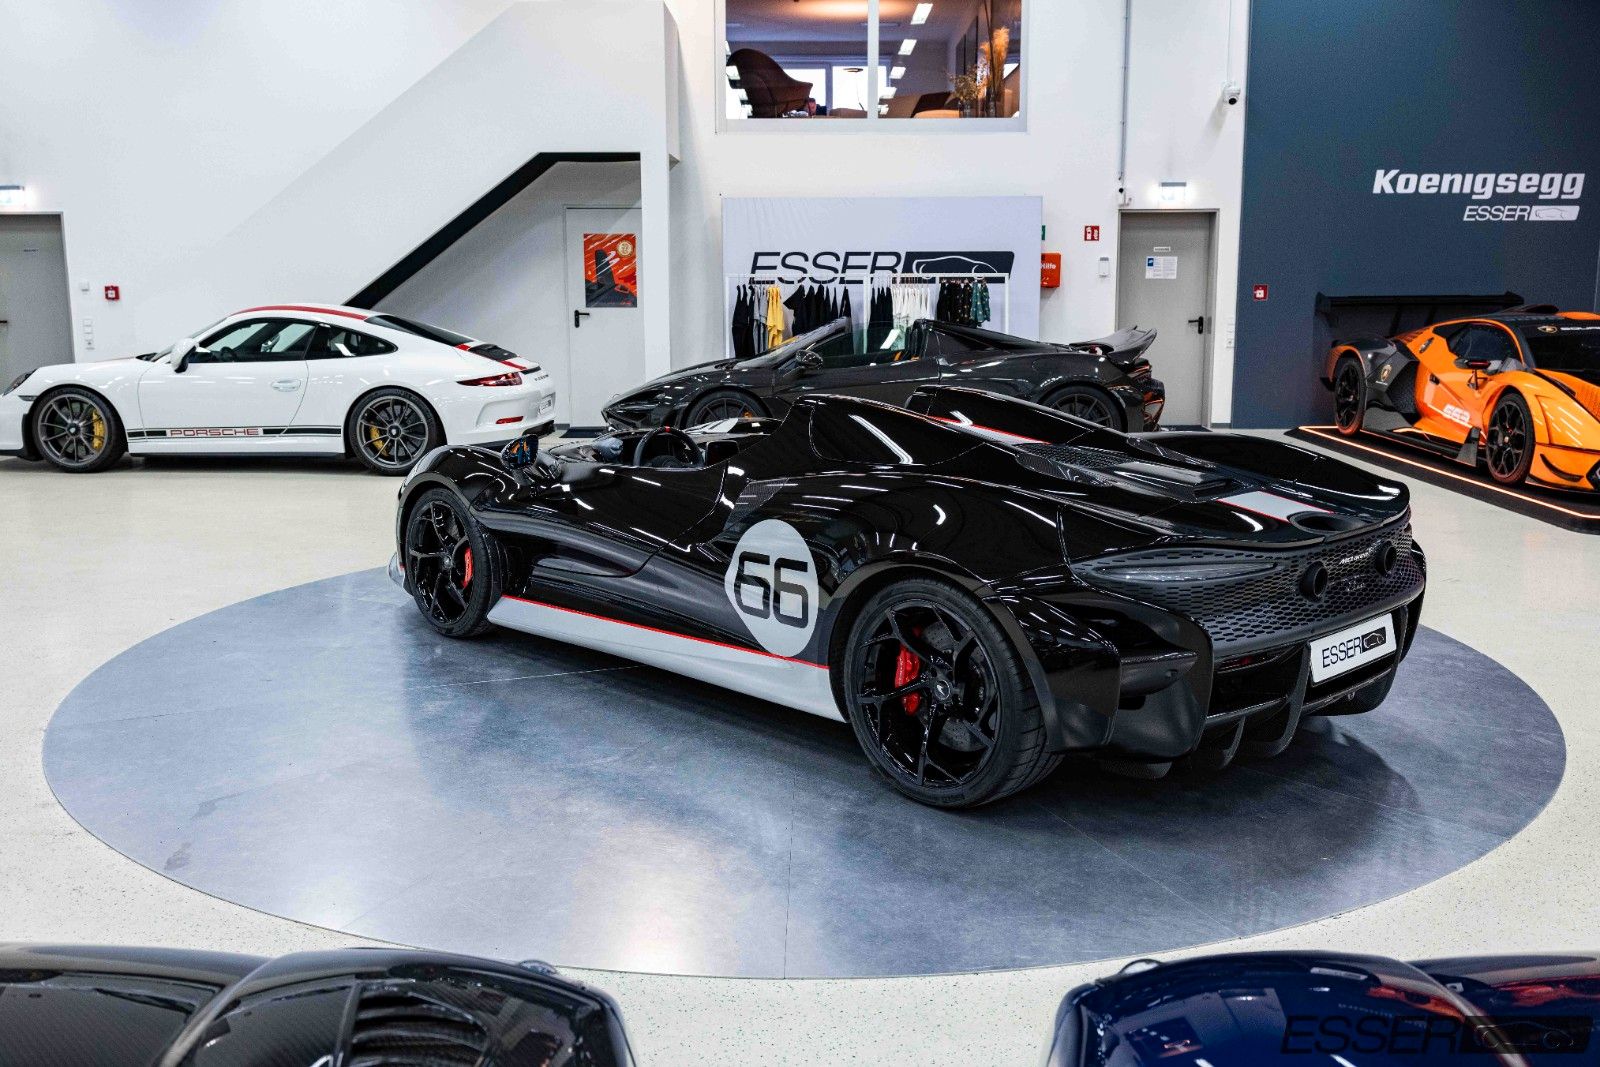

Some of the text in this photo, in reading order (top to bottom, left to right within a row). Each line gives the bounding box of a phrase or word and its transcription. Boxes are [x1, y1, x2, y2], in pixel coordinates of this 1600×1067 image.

[1372, 169, 1585, 199] Koenigsegg
[1463, 205, 1530, 221] ESSER
[749, 251, 902, 284] ESSER
[170, 428, 259, 437] PORSCHE
[733, 550, 809, 629] 66
[1322, 636, 1361, 668] ESSER
